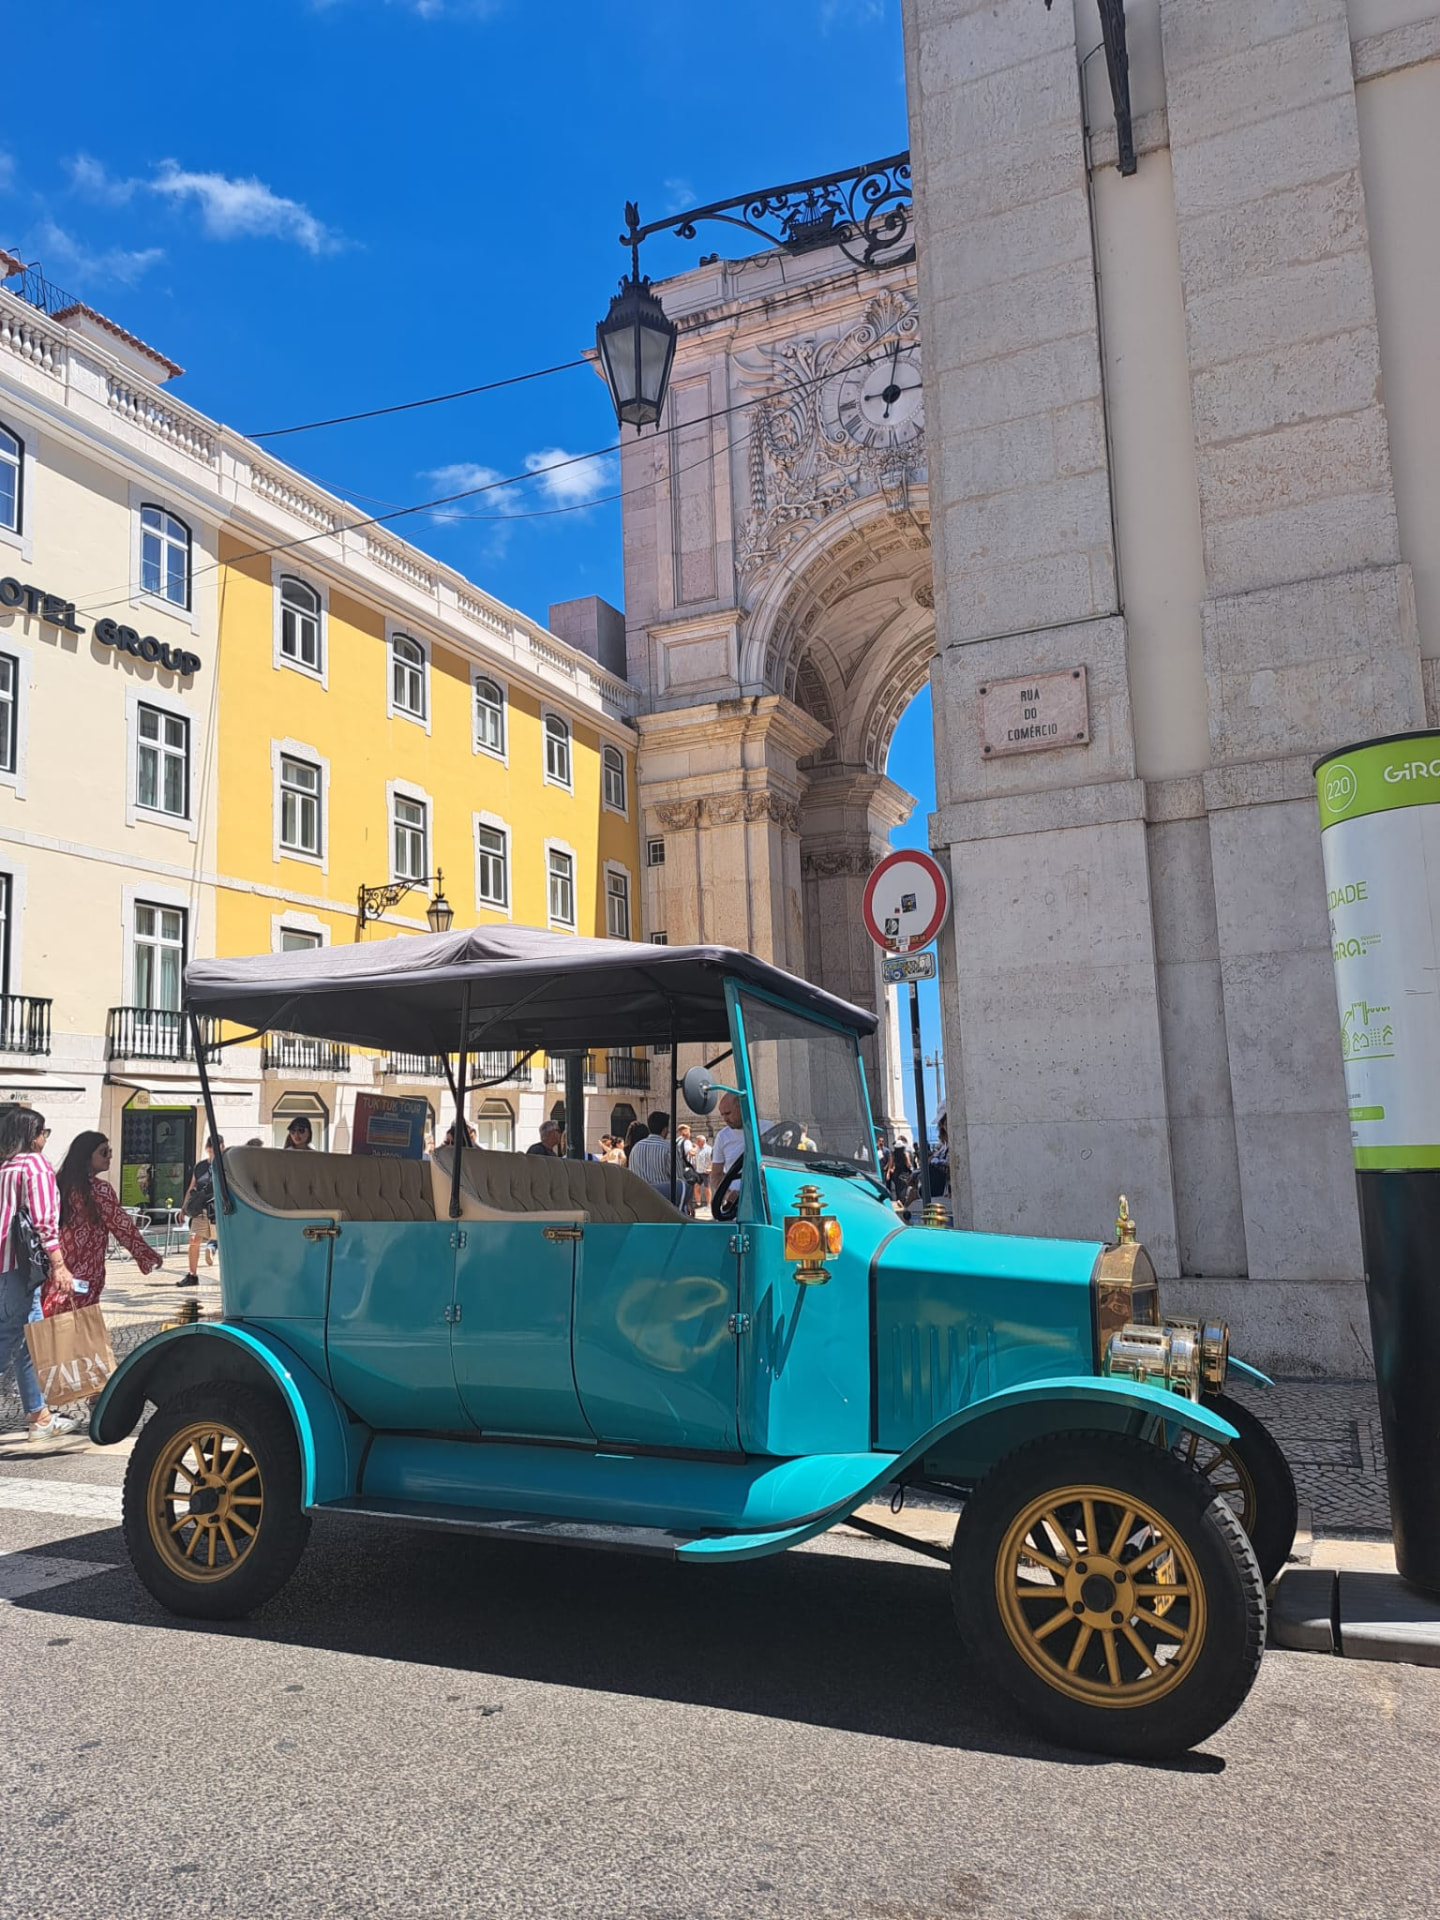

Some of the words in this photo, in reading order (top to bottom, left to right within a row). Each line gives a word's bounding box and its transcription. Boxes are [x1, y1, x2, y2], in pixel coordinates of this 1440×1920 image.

[95, 618, 202, 676] GROUP
[1020, 688, 1040, 702] RUA
[1024, 707, 1037, 720] DO
[1007, 723, 1058, 741] COMÉRCIO
[1326, 776, 1350, 800] 220
[38, 1353, 112, 1400] ZARA
